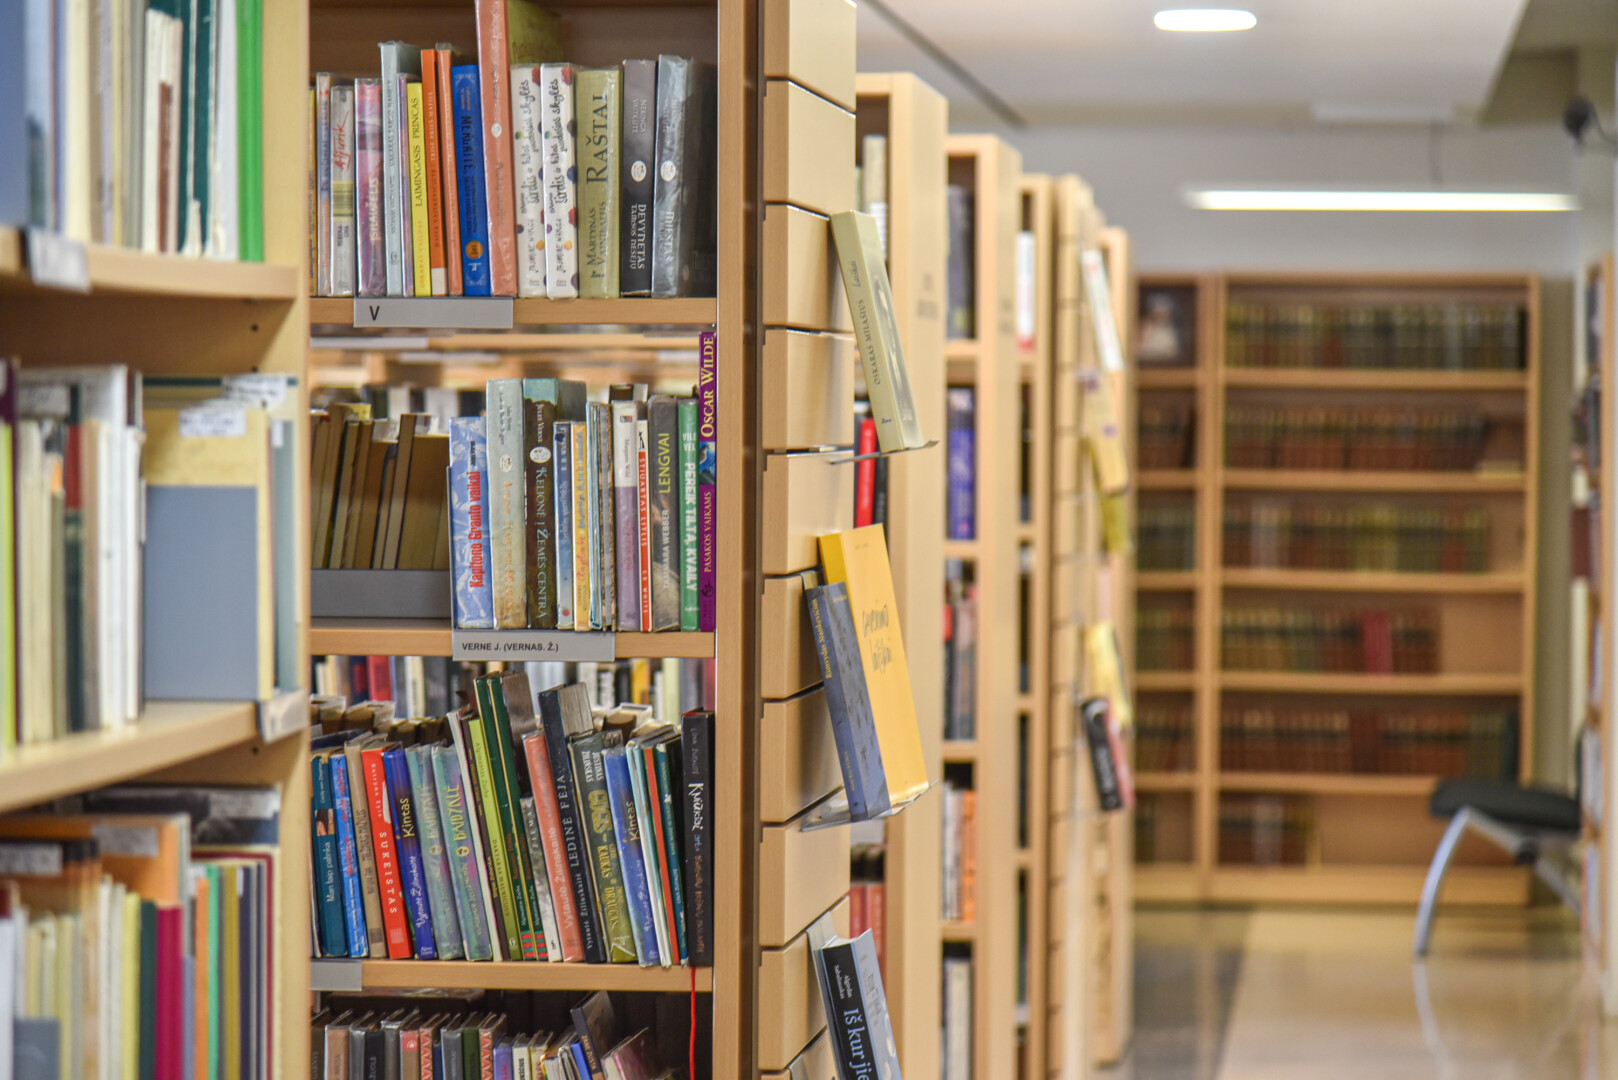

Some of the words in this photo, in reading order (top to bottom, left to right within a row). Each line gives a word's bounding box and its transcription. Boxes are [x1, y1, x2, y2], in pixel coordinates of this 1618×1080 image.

[409, 96, 421, 140] PRINCAS
[411, 144, 424, 207] LAIMINGASIS
[636, 202, 648, 269] DEVYNETAS
[369, 305, 380, 321] V
[857, 297, 874, 344] MILAŠIUS
[700, 336, 715, 385] WILDE
[865, 344, 882, 387] OSKARAS
[700, 390, 715, 438] OSCAR
[657, 432, 672, 494] LENGVAI
[684, 461, 697, 505] PEREIK
[466, 470, 482, 503] vaikai
[534, 466, 548, 519] KELIONĖ
[467, 504, 483, 541] Granto
[703, 490, 713, 532] VAIKAMS
[469, 542, 485, 589] Kapitono
[685, 547, 698, 592] KVAILY
[703, 533, 714, 574] PASAKOS
[462, 642, 492, 651] VERNE
[494, 642, 502, 651] J.
[503, 642, 546, 653] (VERNAS.
[547, 640, 560, 652] Ž.)
[594, 751, 604, 782] JUSTINAS
[553, 774, 574, 810] FĖJA
[399, 797, 417, 838] Kintas
[624, 801, 642, 841] Kintas
[559, 816, 581, 868] LEDINĖ
[596, 844, 613, 878] KAUKAS
[378, 831, 399, 915] SUKEISTAS
[553, 884, 575, 929] Vytautė
[843, 1007, 863, 1026] Iš
[847, 1026, 867, 1059] kur
